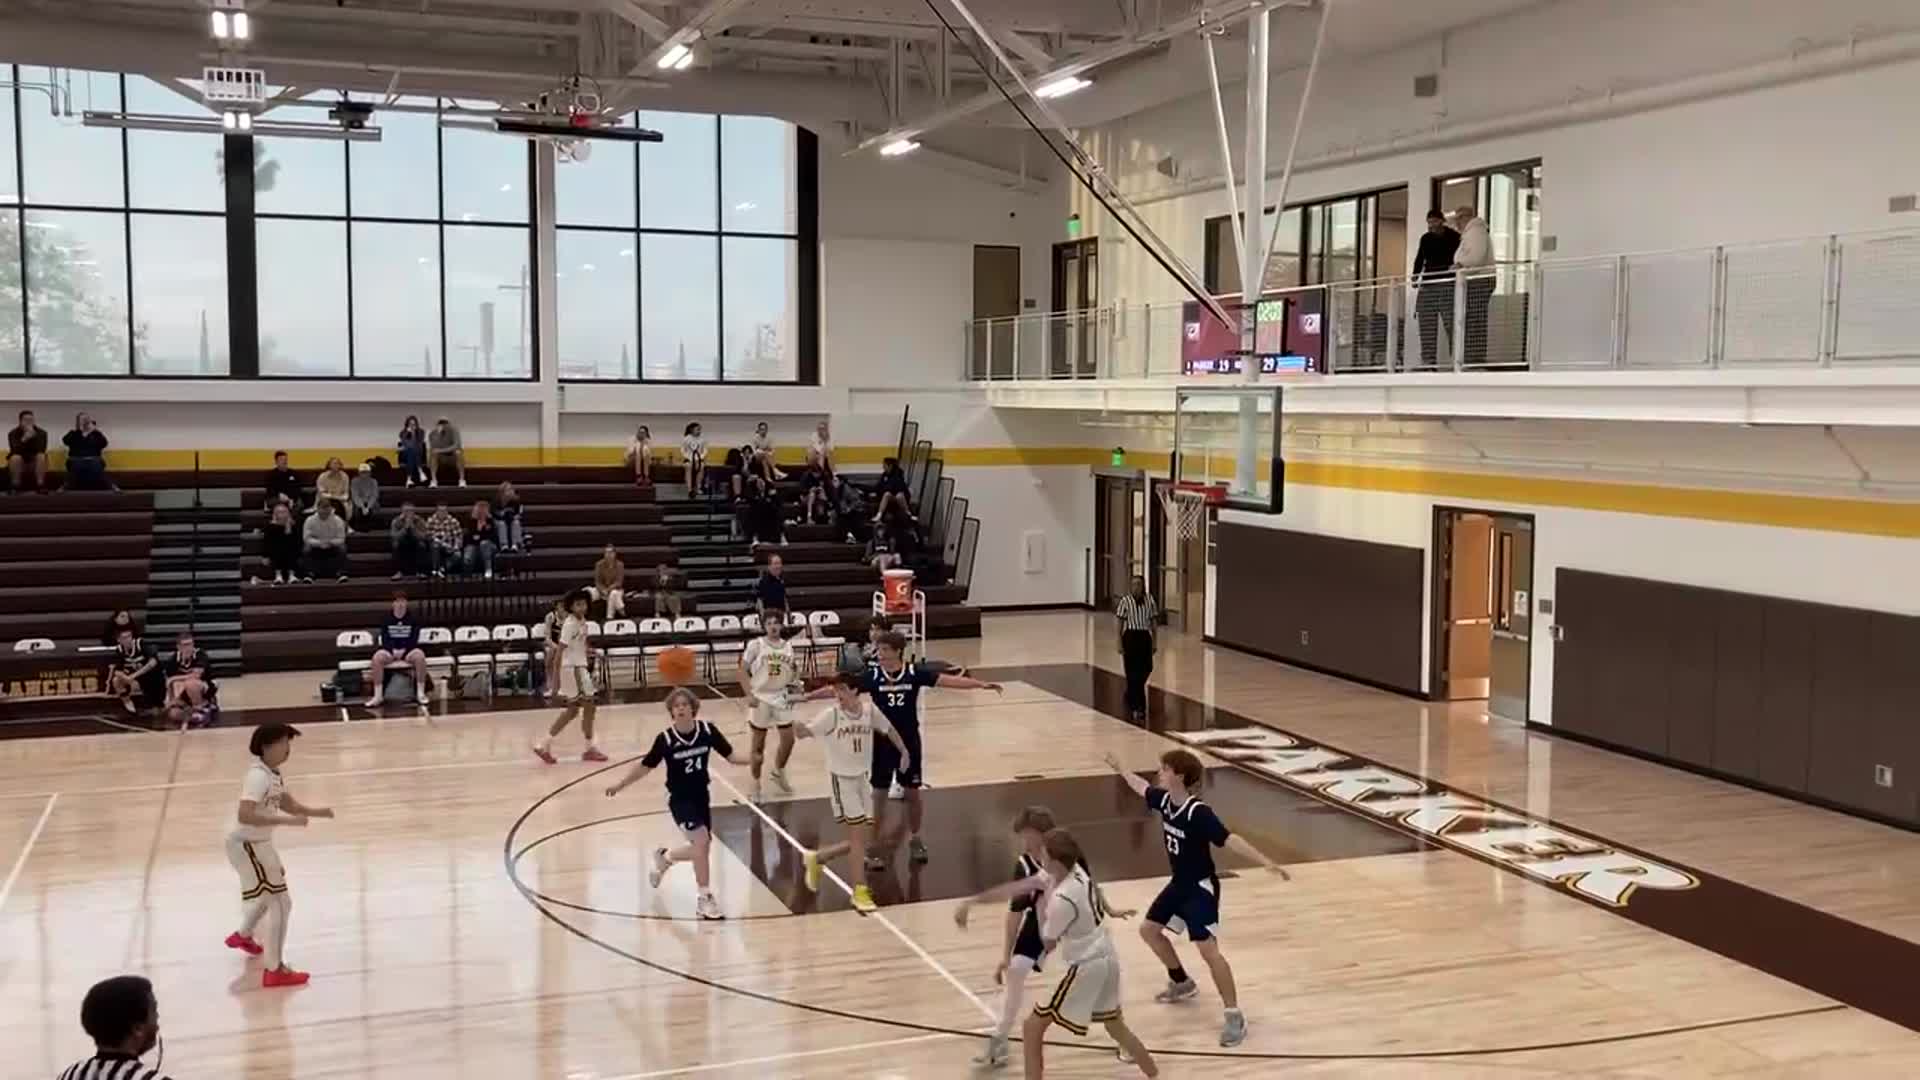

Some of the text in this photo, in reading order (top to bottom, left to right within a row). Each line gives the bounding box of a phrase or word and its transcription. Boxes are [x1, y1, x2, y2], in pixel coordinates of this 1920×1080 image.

[887, 693, 905, 707] 32
[853, 738, 862, 753] 11
[685, 757, 703, 774] 24
[1164, 726, 1700, 908] PARKER
[1166, 834, 1179, 856] 23
